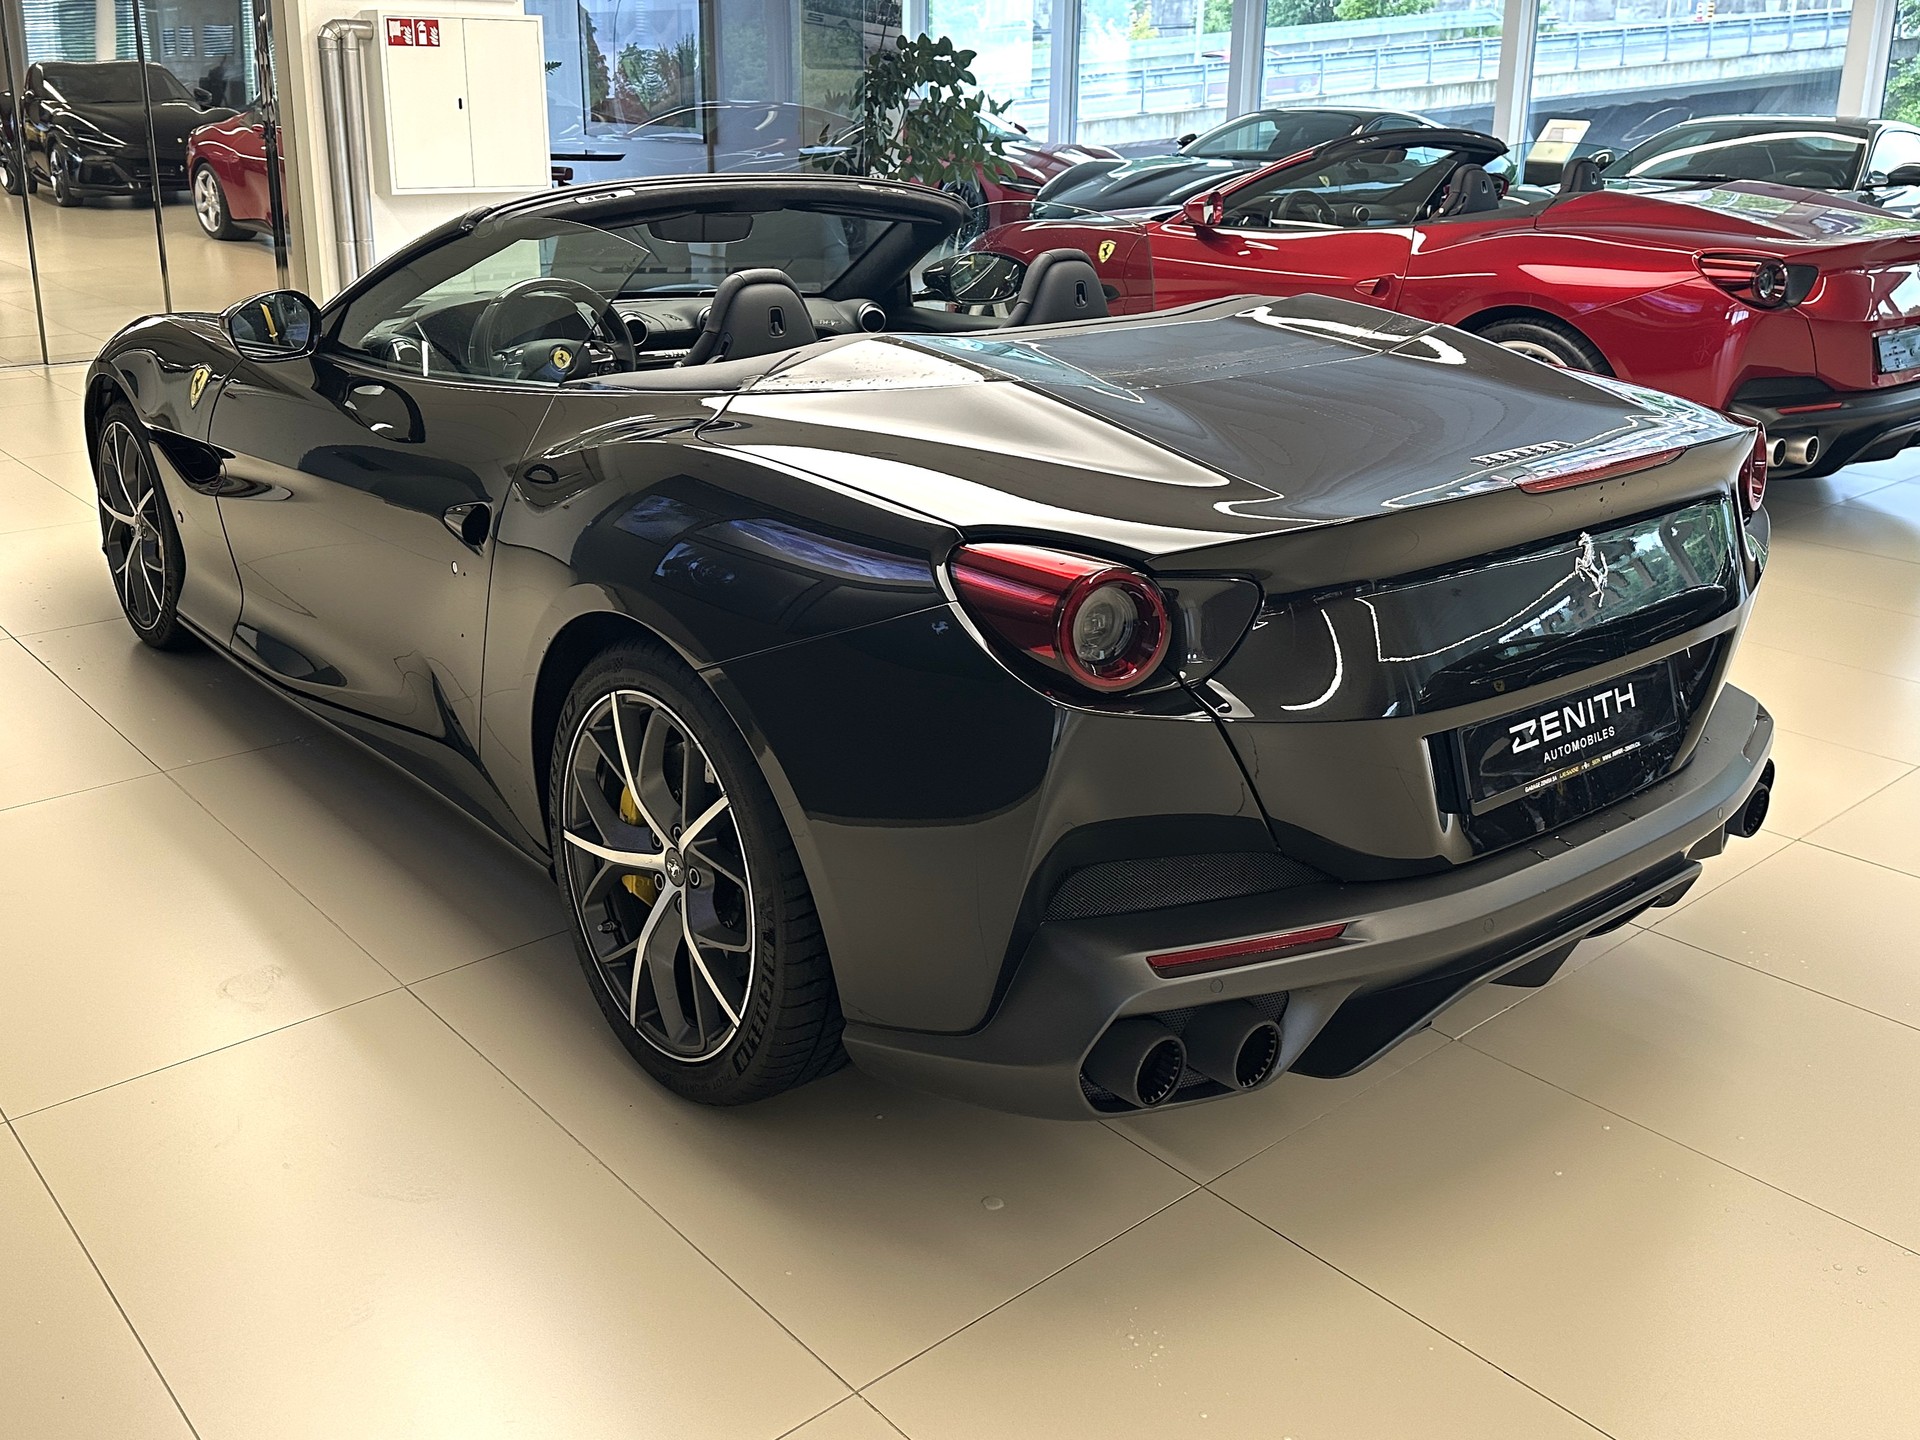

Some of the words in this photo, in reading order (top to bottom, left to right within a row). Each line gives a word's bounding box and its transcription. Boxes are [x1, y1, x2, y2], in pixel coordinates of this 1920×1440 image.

[1509, 683, 1636, 754] ZENITH
[1543, 726, 1615, 763] AUTOMOBILES
[733, 938, 775, 1074] MICHELIN
